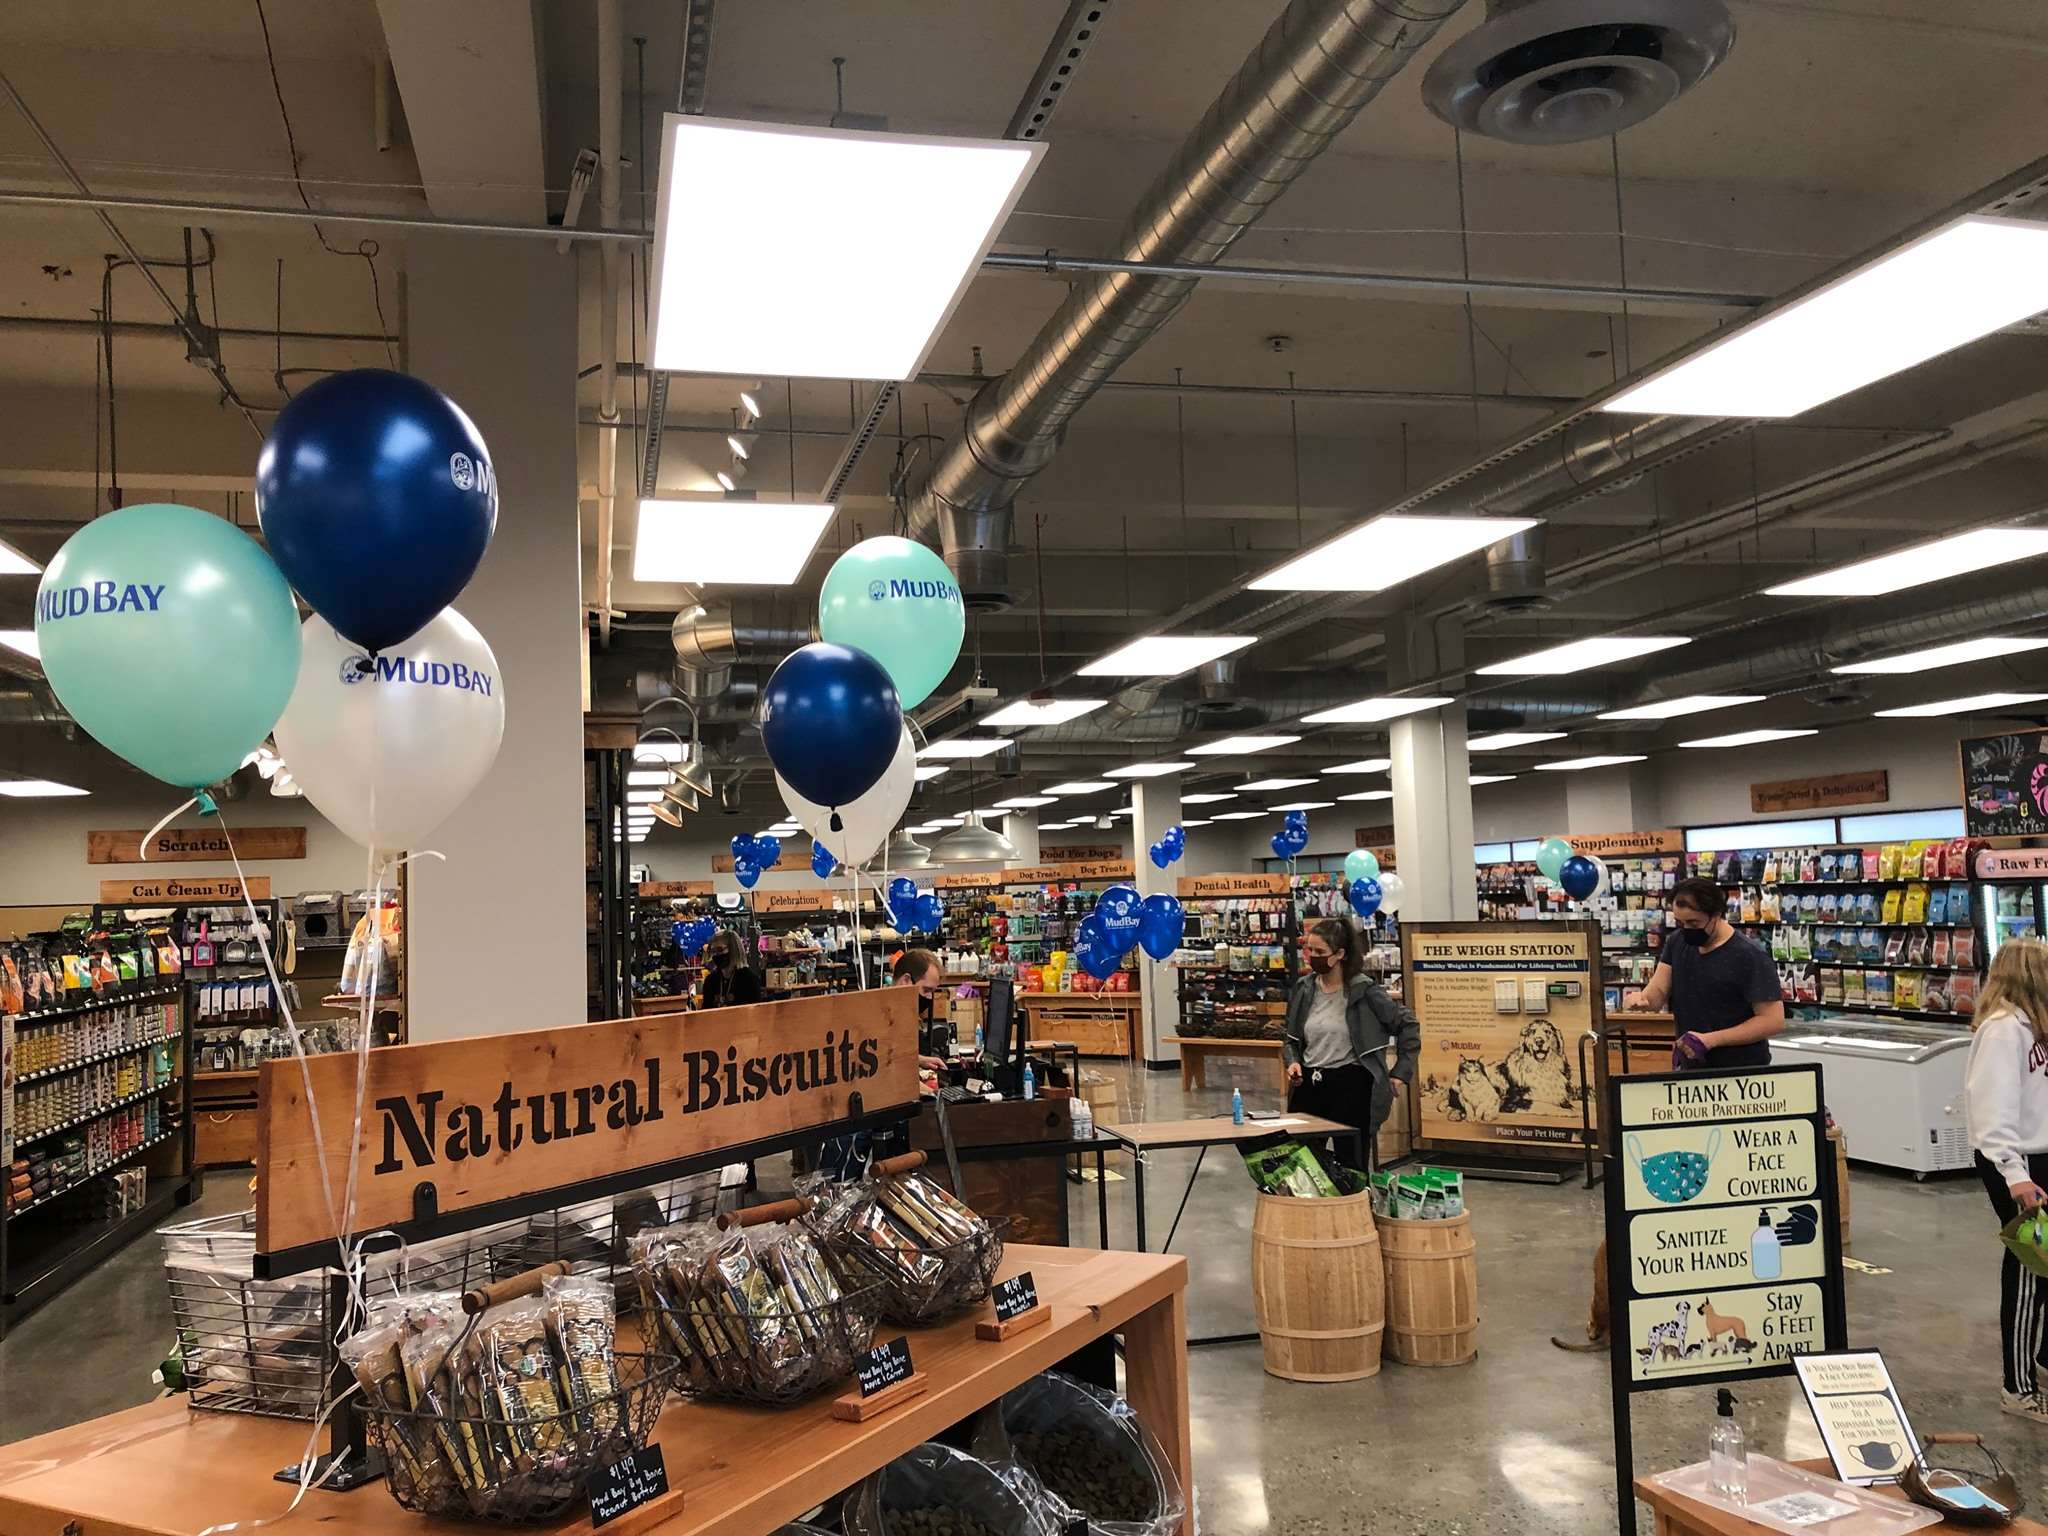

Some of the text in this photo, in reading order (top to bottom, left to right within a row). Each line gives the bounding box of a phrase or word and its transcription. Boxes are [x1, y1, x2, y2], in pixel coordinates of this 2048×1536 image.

[158, 839, 229, 852] Scratch
[1570, 836, 1664, 851] Supplements
[1040, 850, 1114, 859] Food For Dogs
[2000, 859, 2029, 870] Raw
[1019, 870, 1061, 880] Dog Treats
[1080, 865, 1127, 875] Dog Treats
[132, 883, 241, 897] Cat Clean Up
[1194, 880, 1270, 891] Dental Health
[770, 895, 819, 906] Celebrations
[1105, 917, 1140, 928] MudBay
[1423, 944, 1575, 957] THE WEIGH STATION
[374, 1027, 879, 1176] Natural Biscuits
[1662, 1078, 1776, 1105] THANK YOU
[1652, 1099, 1787, 1121] FOR YOUR PARTNERSHIP!
[1496, 1127, 1566, 1139] Place Your Pet Here
[1733, 1128, 1798, 1149] WEAR A
[1747, 1152, 1786, 1172] FACE
[1728, 1176, 1808, 1198] COVERING
[1656, 1228, 1729, 1250] SANITIZE
[1638, 1250, 1748, 1277] YOUR HANDS
[1766, 1291, 1803, 1314] Stay
[1763, 1315, 1816, 1337] 6 FEET
[870, 1343, 891, 1362] $1.49
[1763, 1339, 1813, 1362] APART
[609, 1456, 637, 1480] $1.49
[591, 1491, 609, 1509] Mud
[610, 1486, 626, 1498] Bay
[600, 1497, 628, 1517] Peanut
